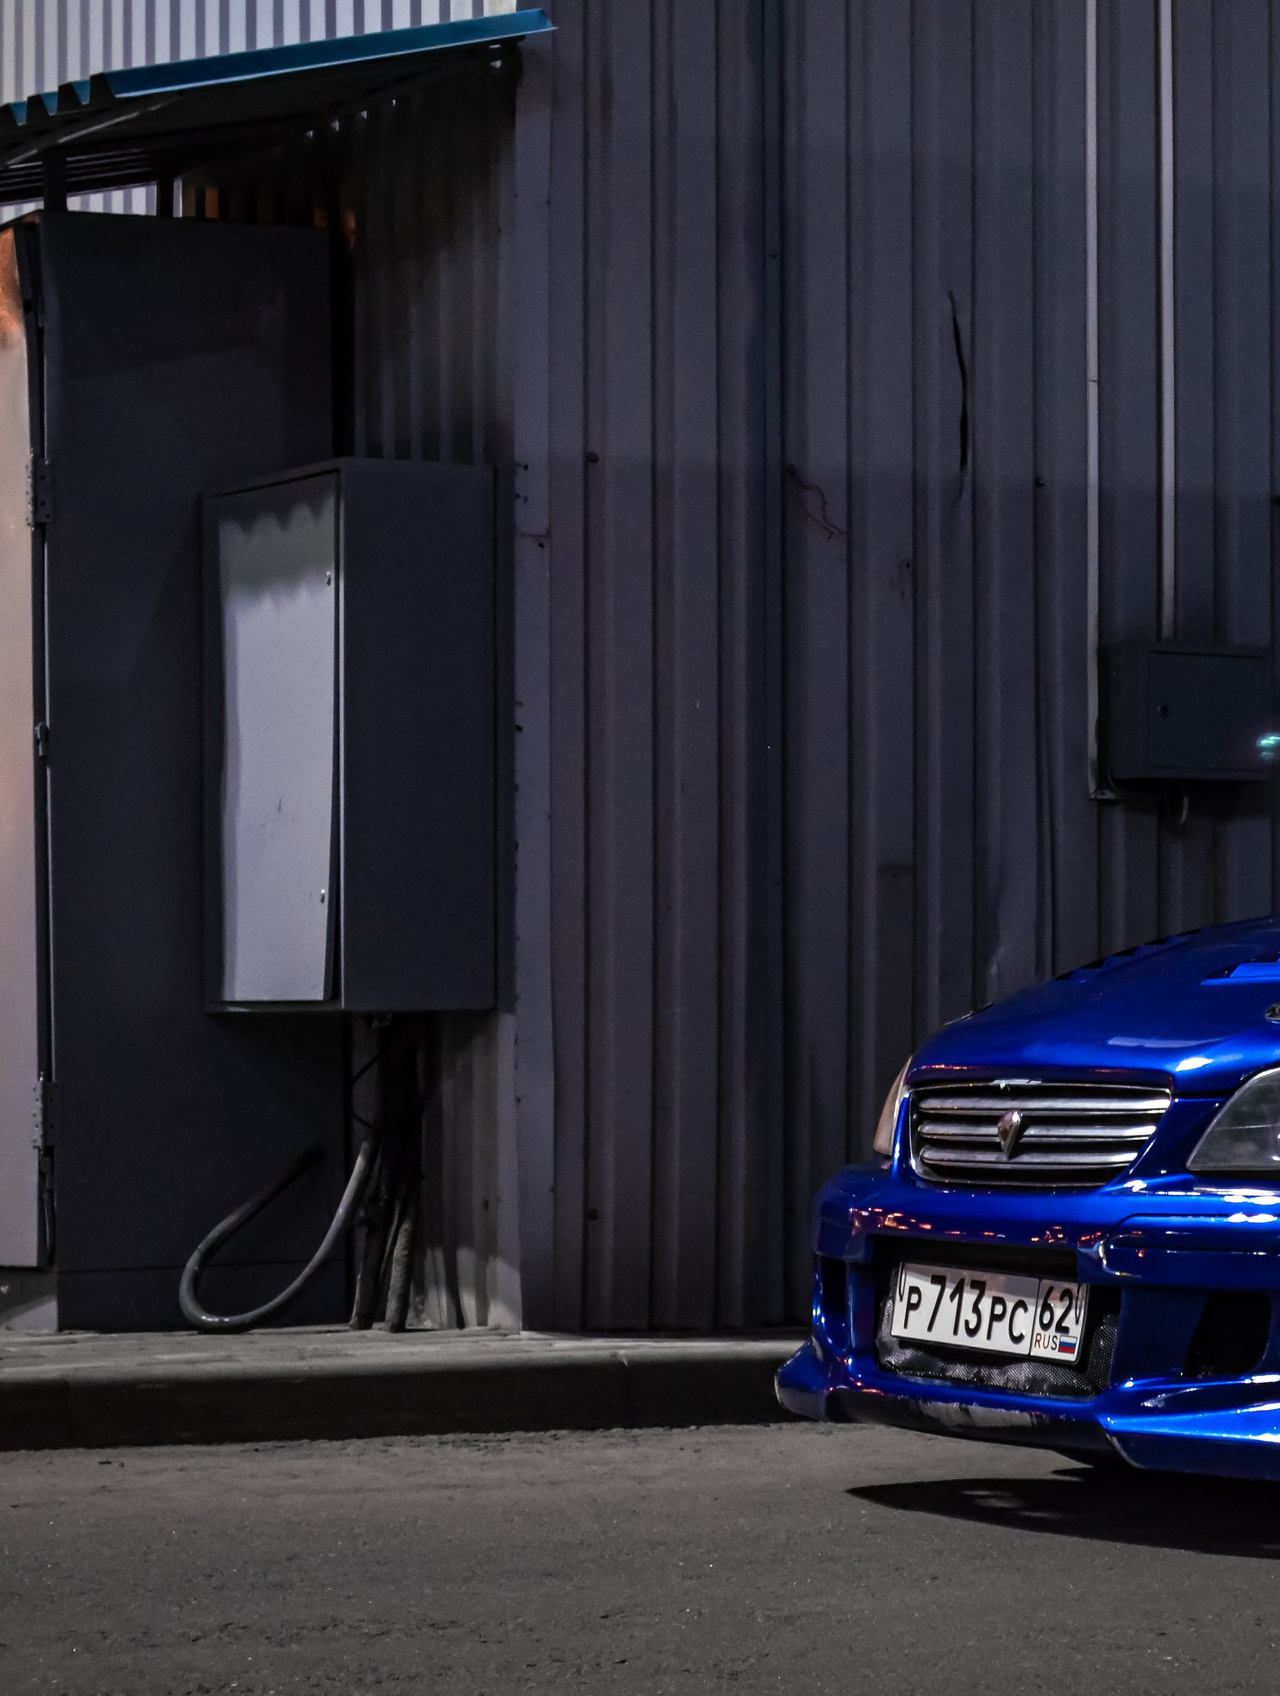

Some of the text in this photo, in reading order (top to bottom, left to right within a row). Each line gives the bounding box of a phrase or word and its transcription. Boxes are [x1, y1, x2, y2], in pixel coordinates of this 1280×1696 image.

[903, 1275, 1074, 1345] P713PC 62
[1034, 1332, 1058, 1351] RUS
